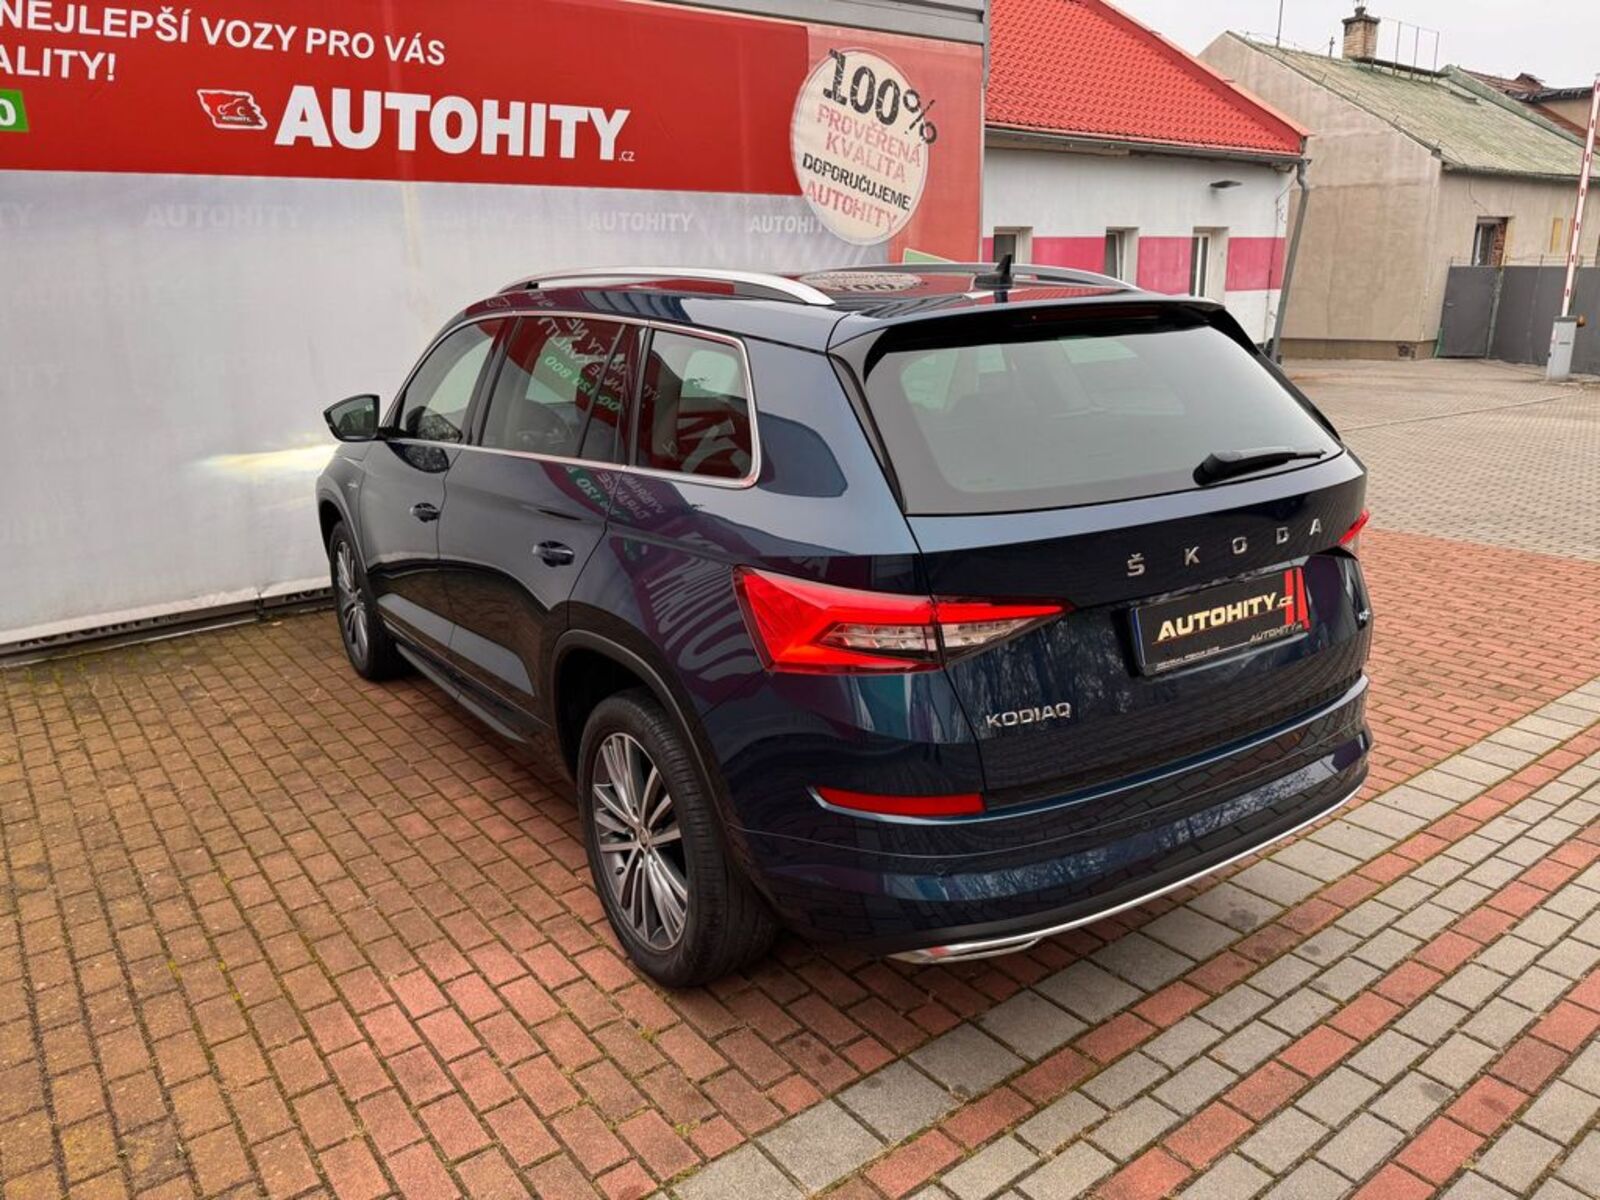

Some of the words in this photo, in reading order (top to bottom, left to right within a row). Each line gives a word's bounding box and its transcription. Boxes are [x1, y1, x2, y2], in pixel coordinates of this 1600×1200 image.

[0, 0, 191, 43] NEJLEPŠÍ
[200, 17, 297, 52] VOZY
[305, 27, 375, 58] PRO
[384, 33, 446, 66] VÁS
[822, 48, 937, 145] 100%
[817, 104, 921, 168] PROVĚŘENÁ
[826, 132, 905, 183] KVALITA
[803, 153, 911, 212] DOPORUČUJEME
[803, 181, 898, 232] AUTOHITY
[587, 211, 694, 233] AUTOHITY
[985, 701, 1072, 729] KODIAQ
